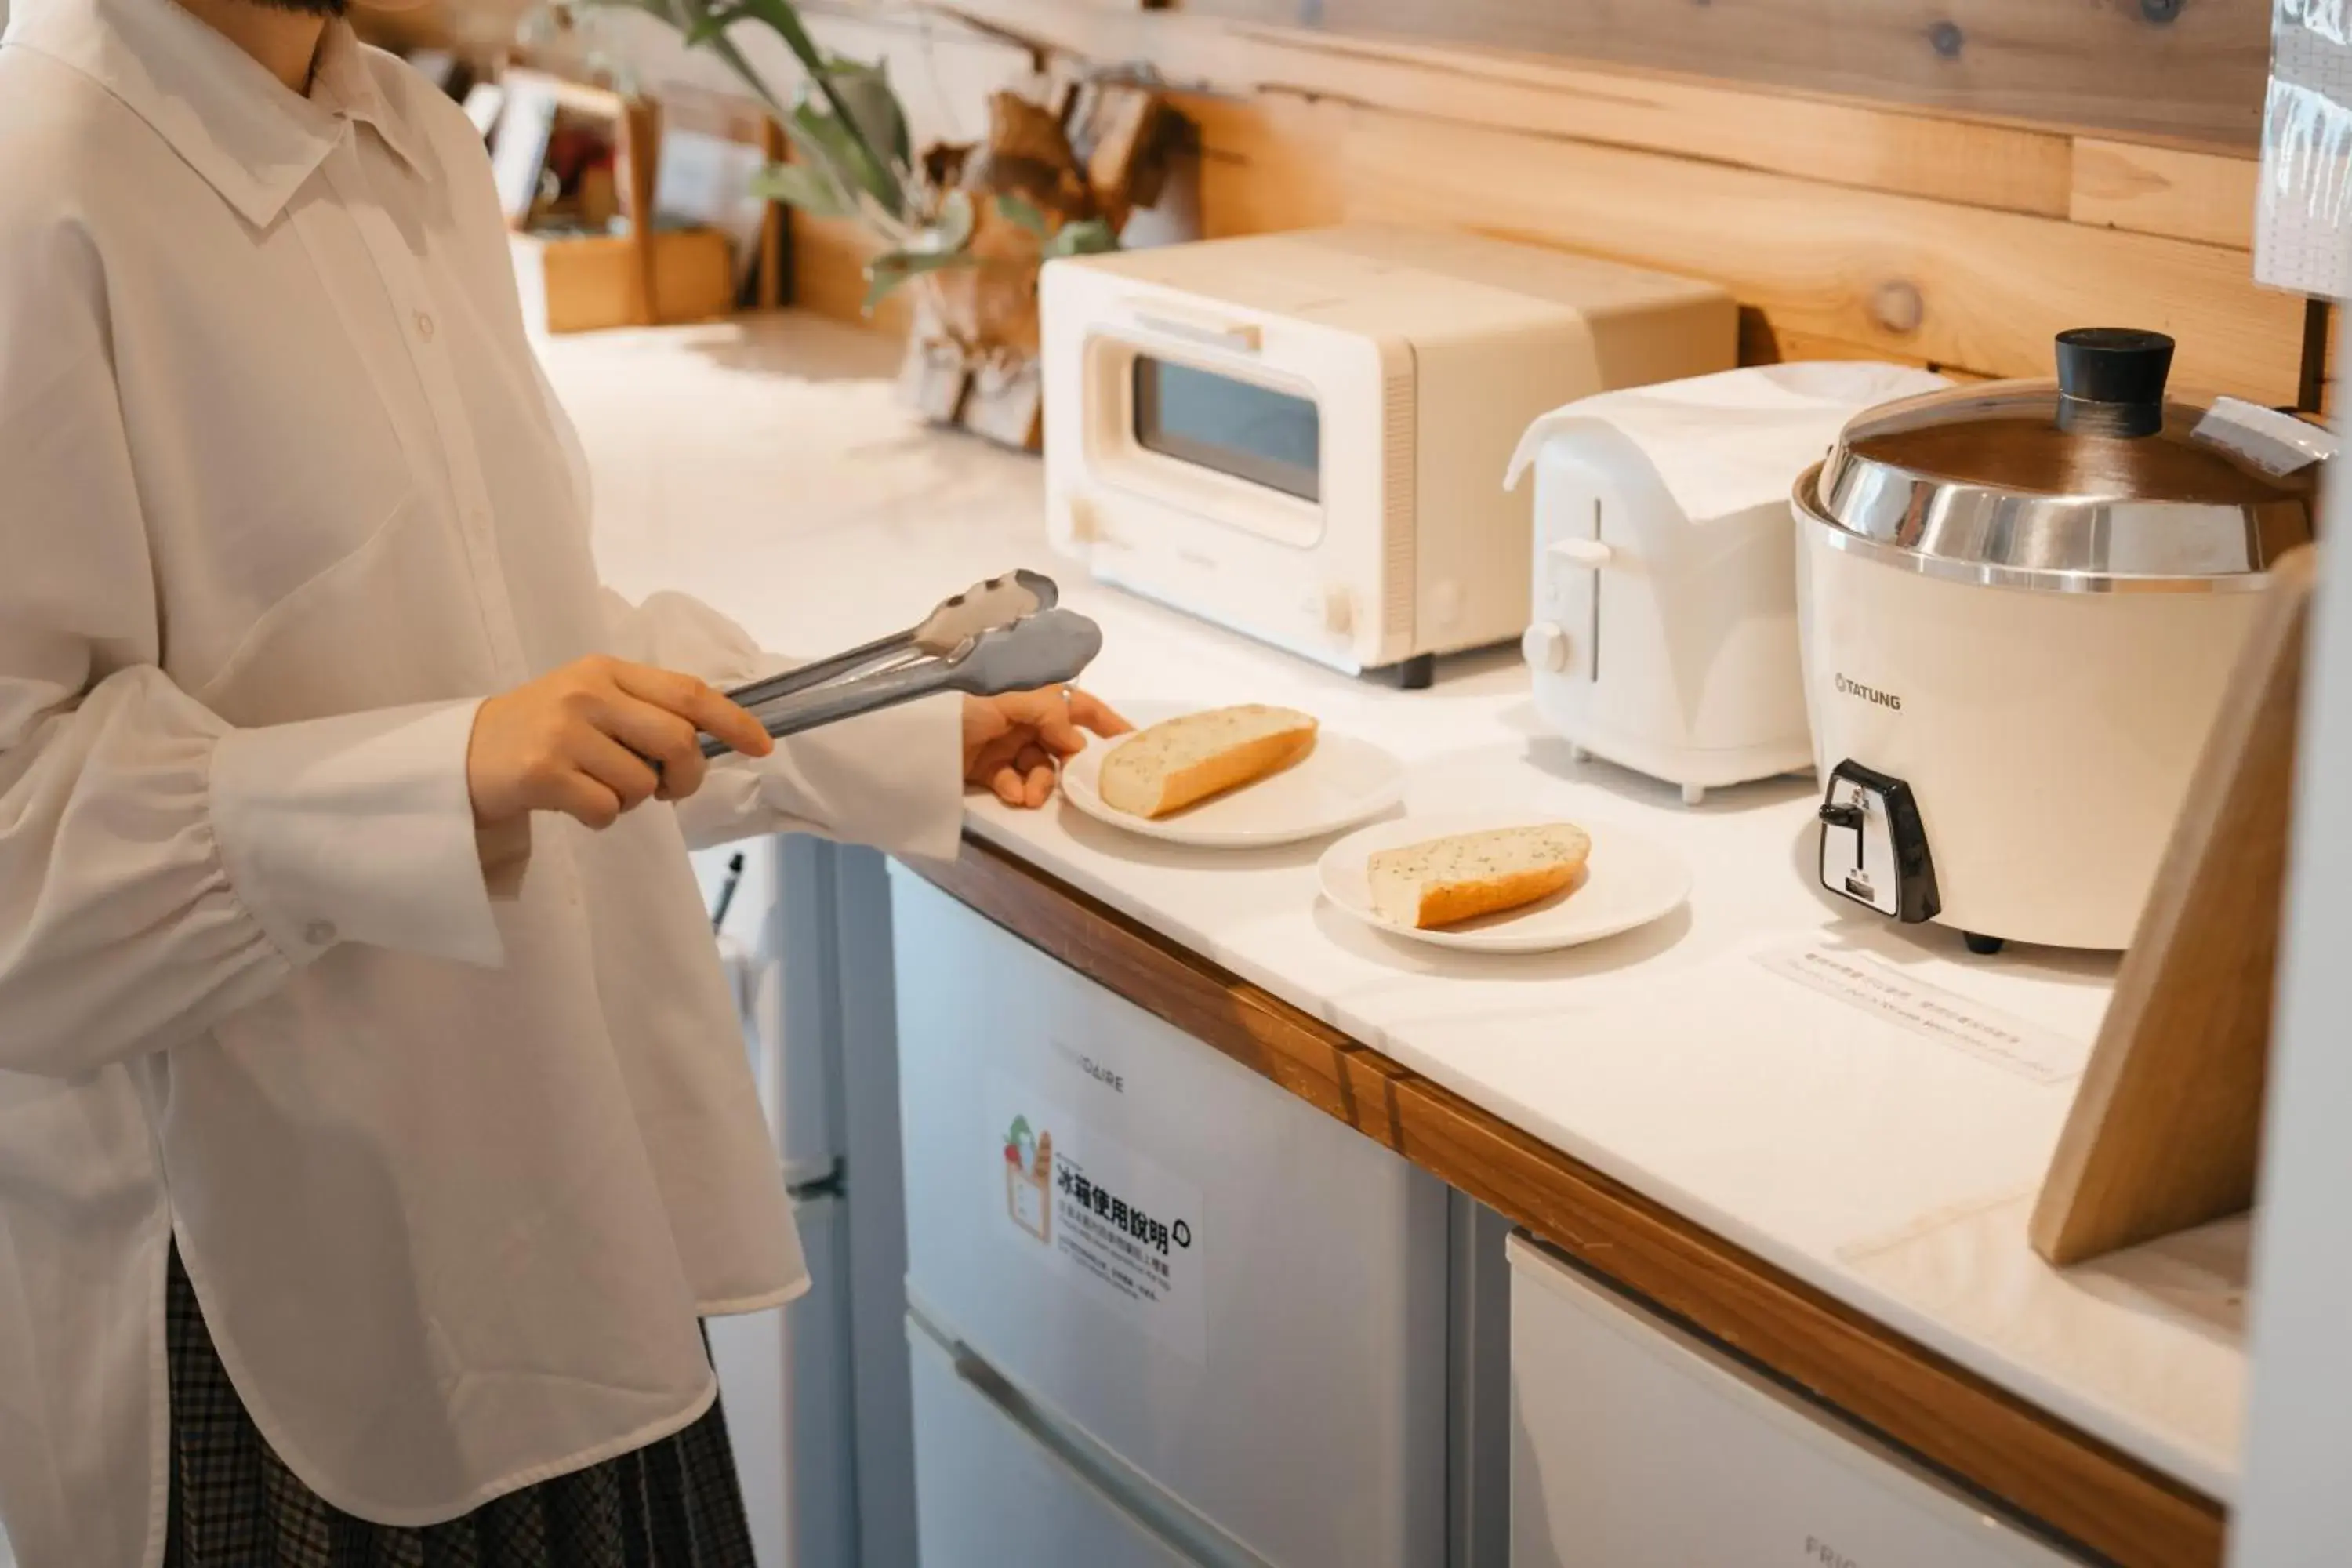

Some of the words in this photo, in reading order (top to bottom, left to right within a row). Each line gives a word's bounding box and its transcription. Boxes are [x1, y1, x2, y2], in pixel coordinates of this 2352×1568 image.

[1846, 679, 1901, 710] TATUNG
[1057, 1163, 1168, 1255] 冰箱使用說明
